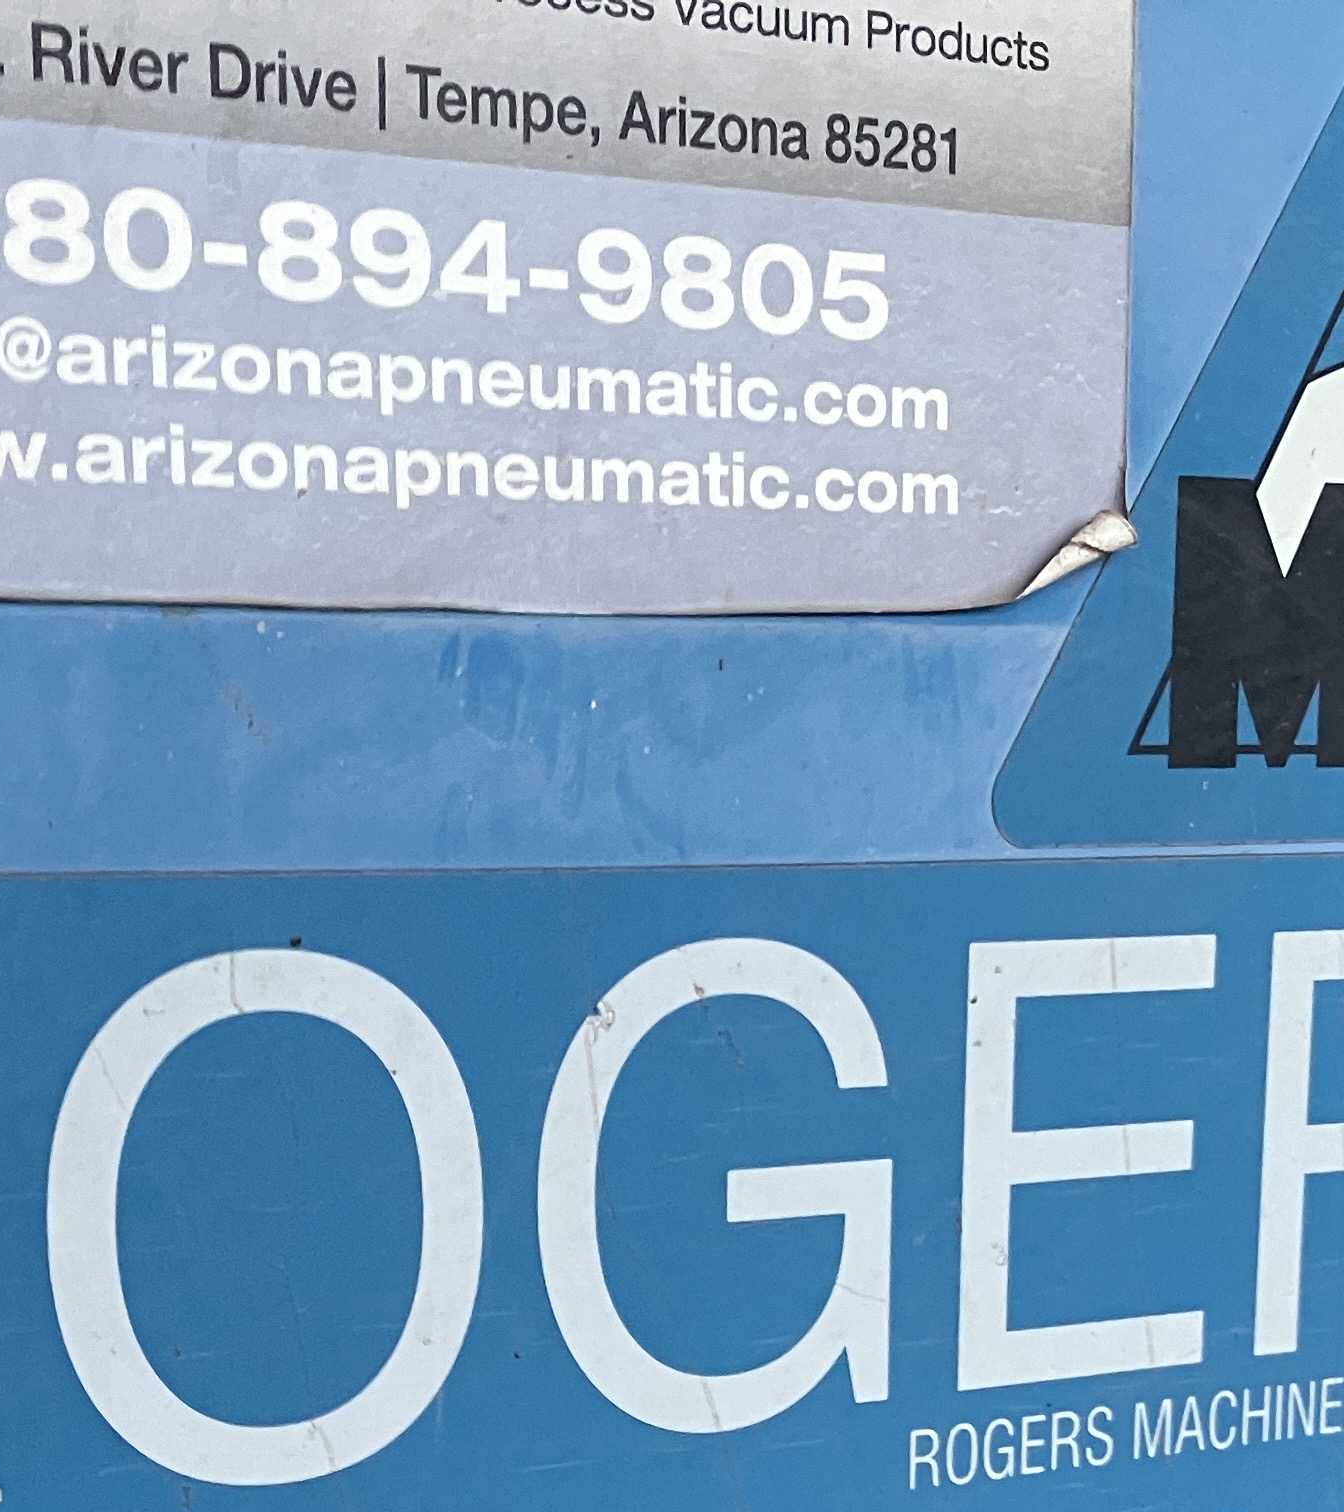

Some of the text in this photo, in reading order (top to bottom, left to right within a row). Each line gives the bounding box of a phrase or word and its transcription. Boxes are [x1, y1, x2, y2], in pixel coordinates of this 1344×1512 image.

[675, 0, 1051, 72] Vacuum Products
[32, 20, 189, 94] River
[209, 42, 358, 113] Drive
[406, 62, 601, 147] Tempe,
[618, 90, 810, 161] Arizona
[824, 112, 958, 175] 85281
[908, 1407, 1114, 1490] ROGERS
